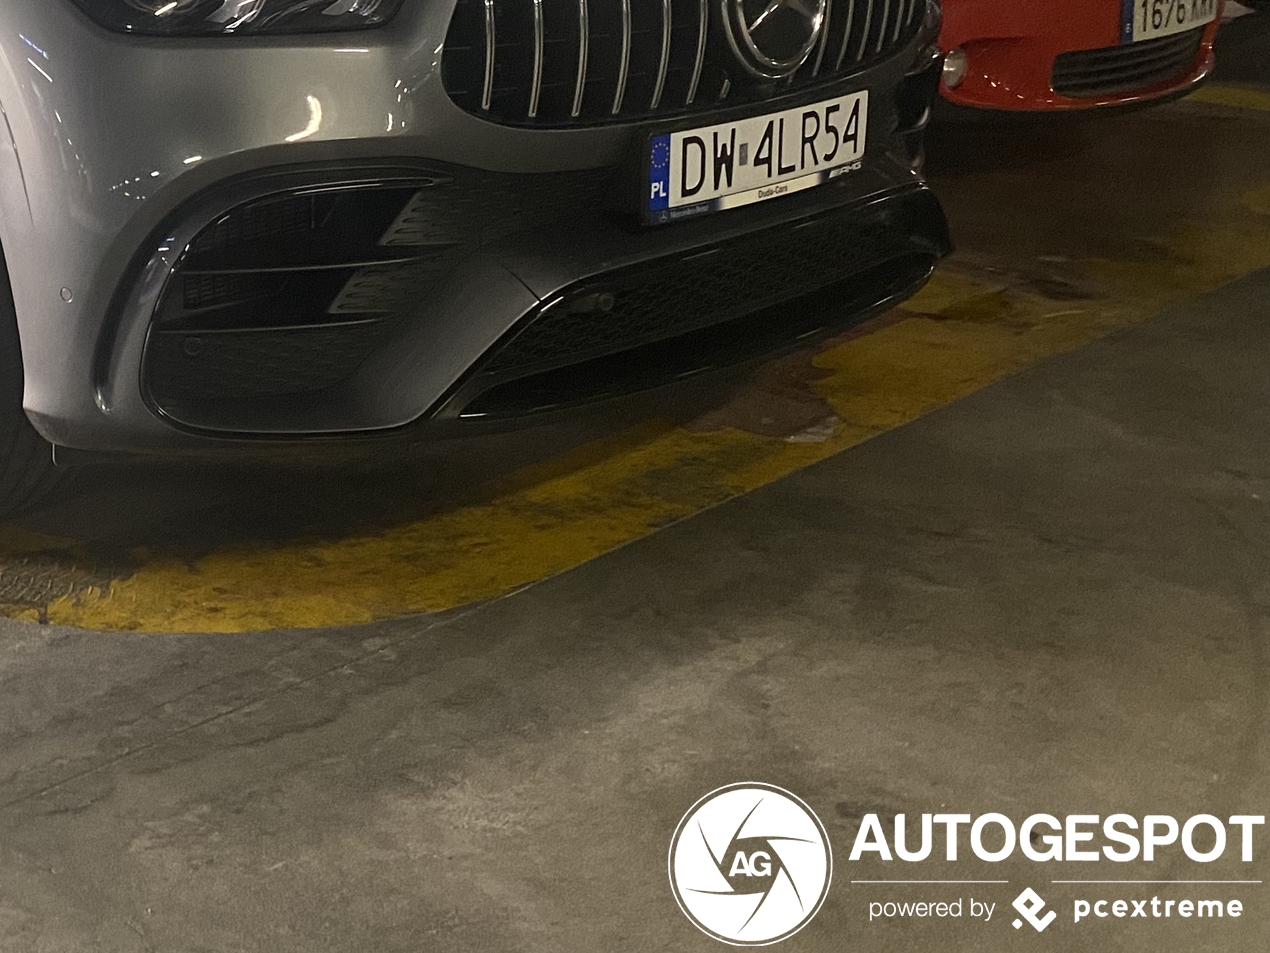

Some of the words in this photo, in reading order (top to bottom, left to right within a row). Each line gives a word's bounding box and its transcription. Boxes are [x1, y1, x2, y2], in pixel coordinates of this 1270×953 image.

[681, 128, 735, 198] DW
[753, 98, 861, 178] 4LR54
[651, 181, 667, 199] PL
